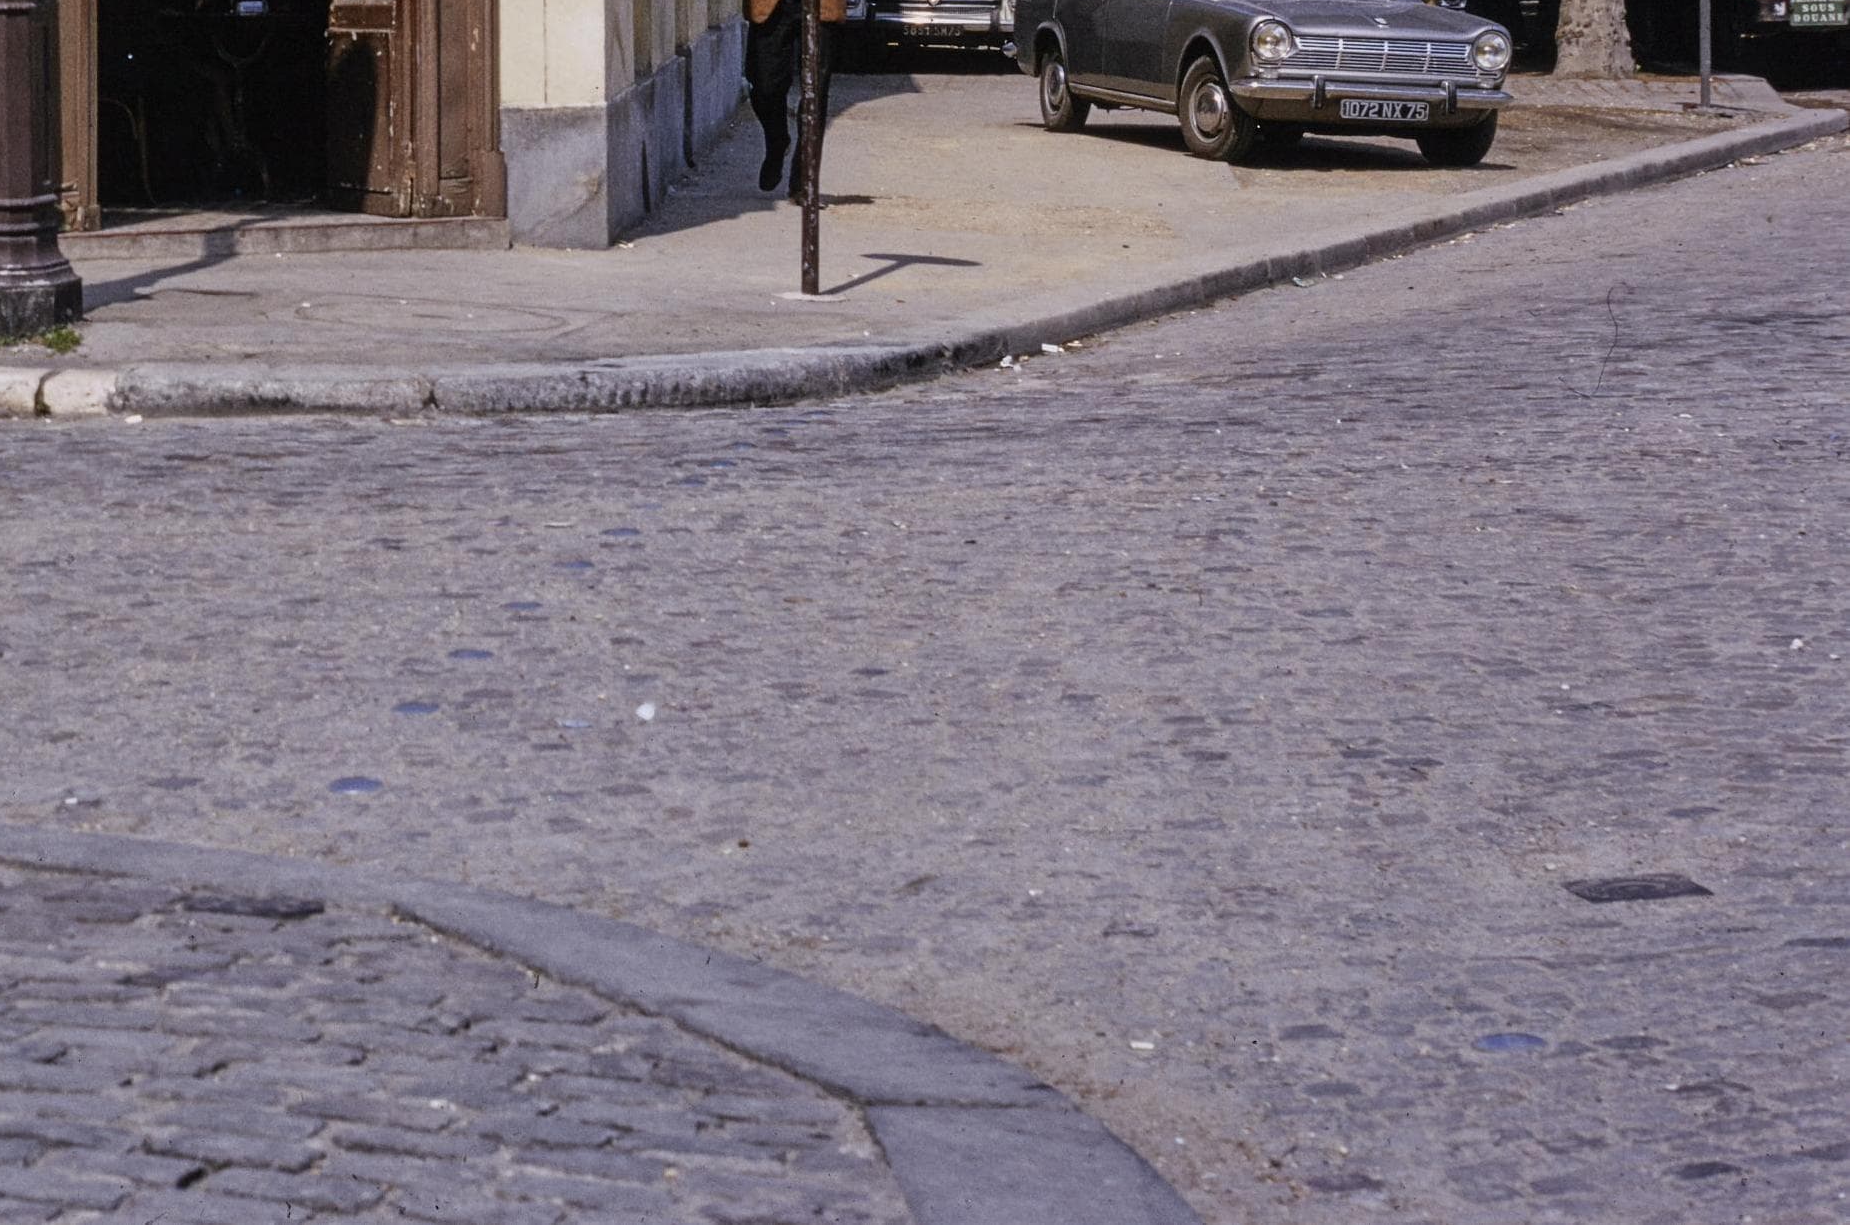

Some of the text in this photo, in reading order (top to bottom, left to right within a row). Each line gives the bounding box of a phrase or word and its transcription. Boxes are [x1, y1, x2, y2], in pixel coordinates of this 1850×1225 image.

[1801, 3, 1835, 13] SOUS
[1793, 13, 1844, 22] DOUANE
[1345, 101, 1425, 119] 1072 NX 75
